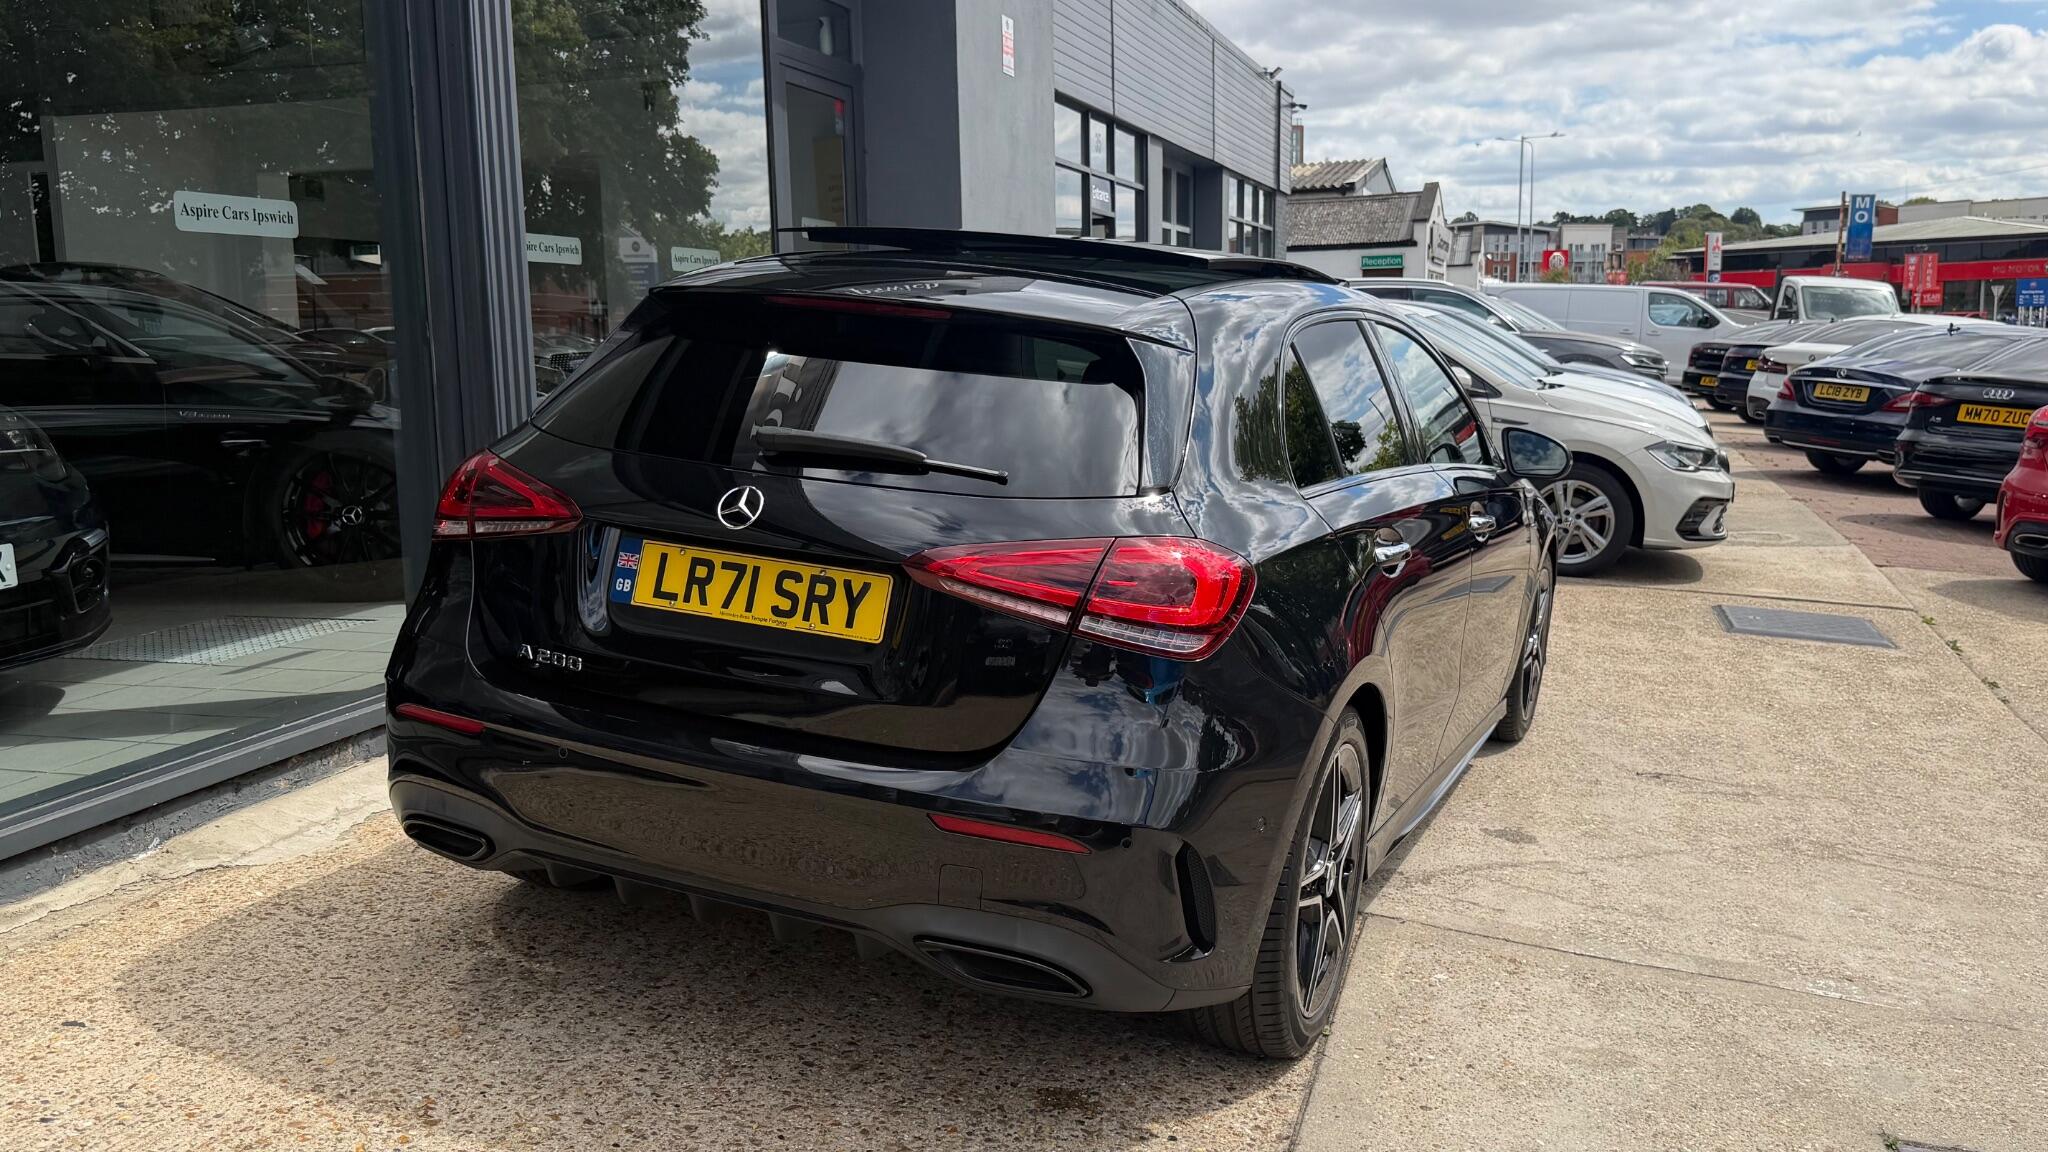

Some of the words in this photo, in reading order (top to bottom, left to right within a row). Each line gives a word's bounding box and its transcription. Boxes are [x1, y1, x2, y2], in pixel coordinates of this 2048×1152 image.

[180, 202, 219, 221] Aspire
[222, 205, 250, 221] Cars
[253, 207, 294, 226] Ipswich
[538, 241, 554, 254] Cars
[555, 243, 580, 257] Ipswich
[674, 254, 690, 266] Aspire
[690, 255, 701, 265] Cars
[1362, 257, 1402, 266] Reception
[1820, 384, 1841, 396] LC18
[1843, 387, 1862, 398] ZYB
[1964, 407, 2000, 423] MM70
[615, 578, 631, 592] GB
[652, 552, 761, 613] LR71
[770, 569, 872, 629] SRY
[751, 615, 769, 624] Temple
[519, 643, 533, 660] A
[536, 648, 582, 671] 200
